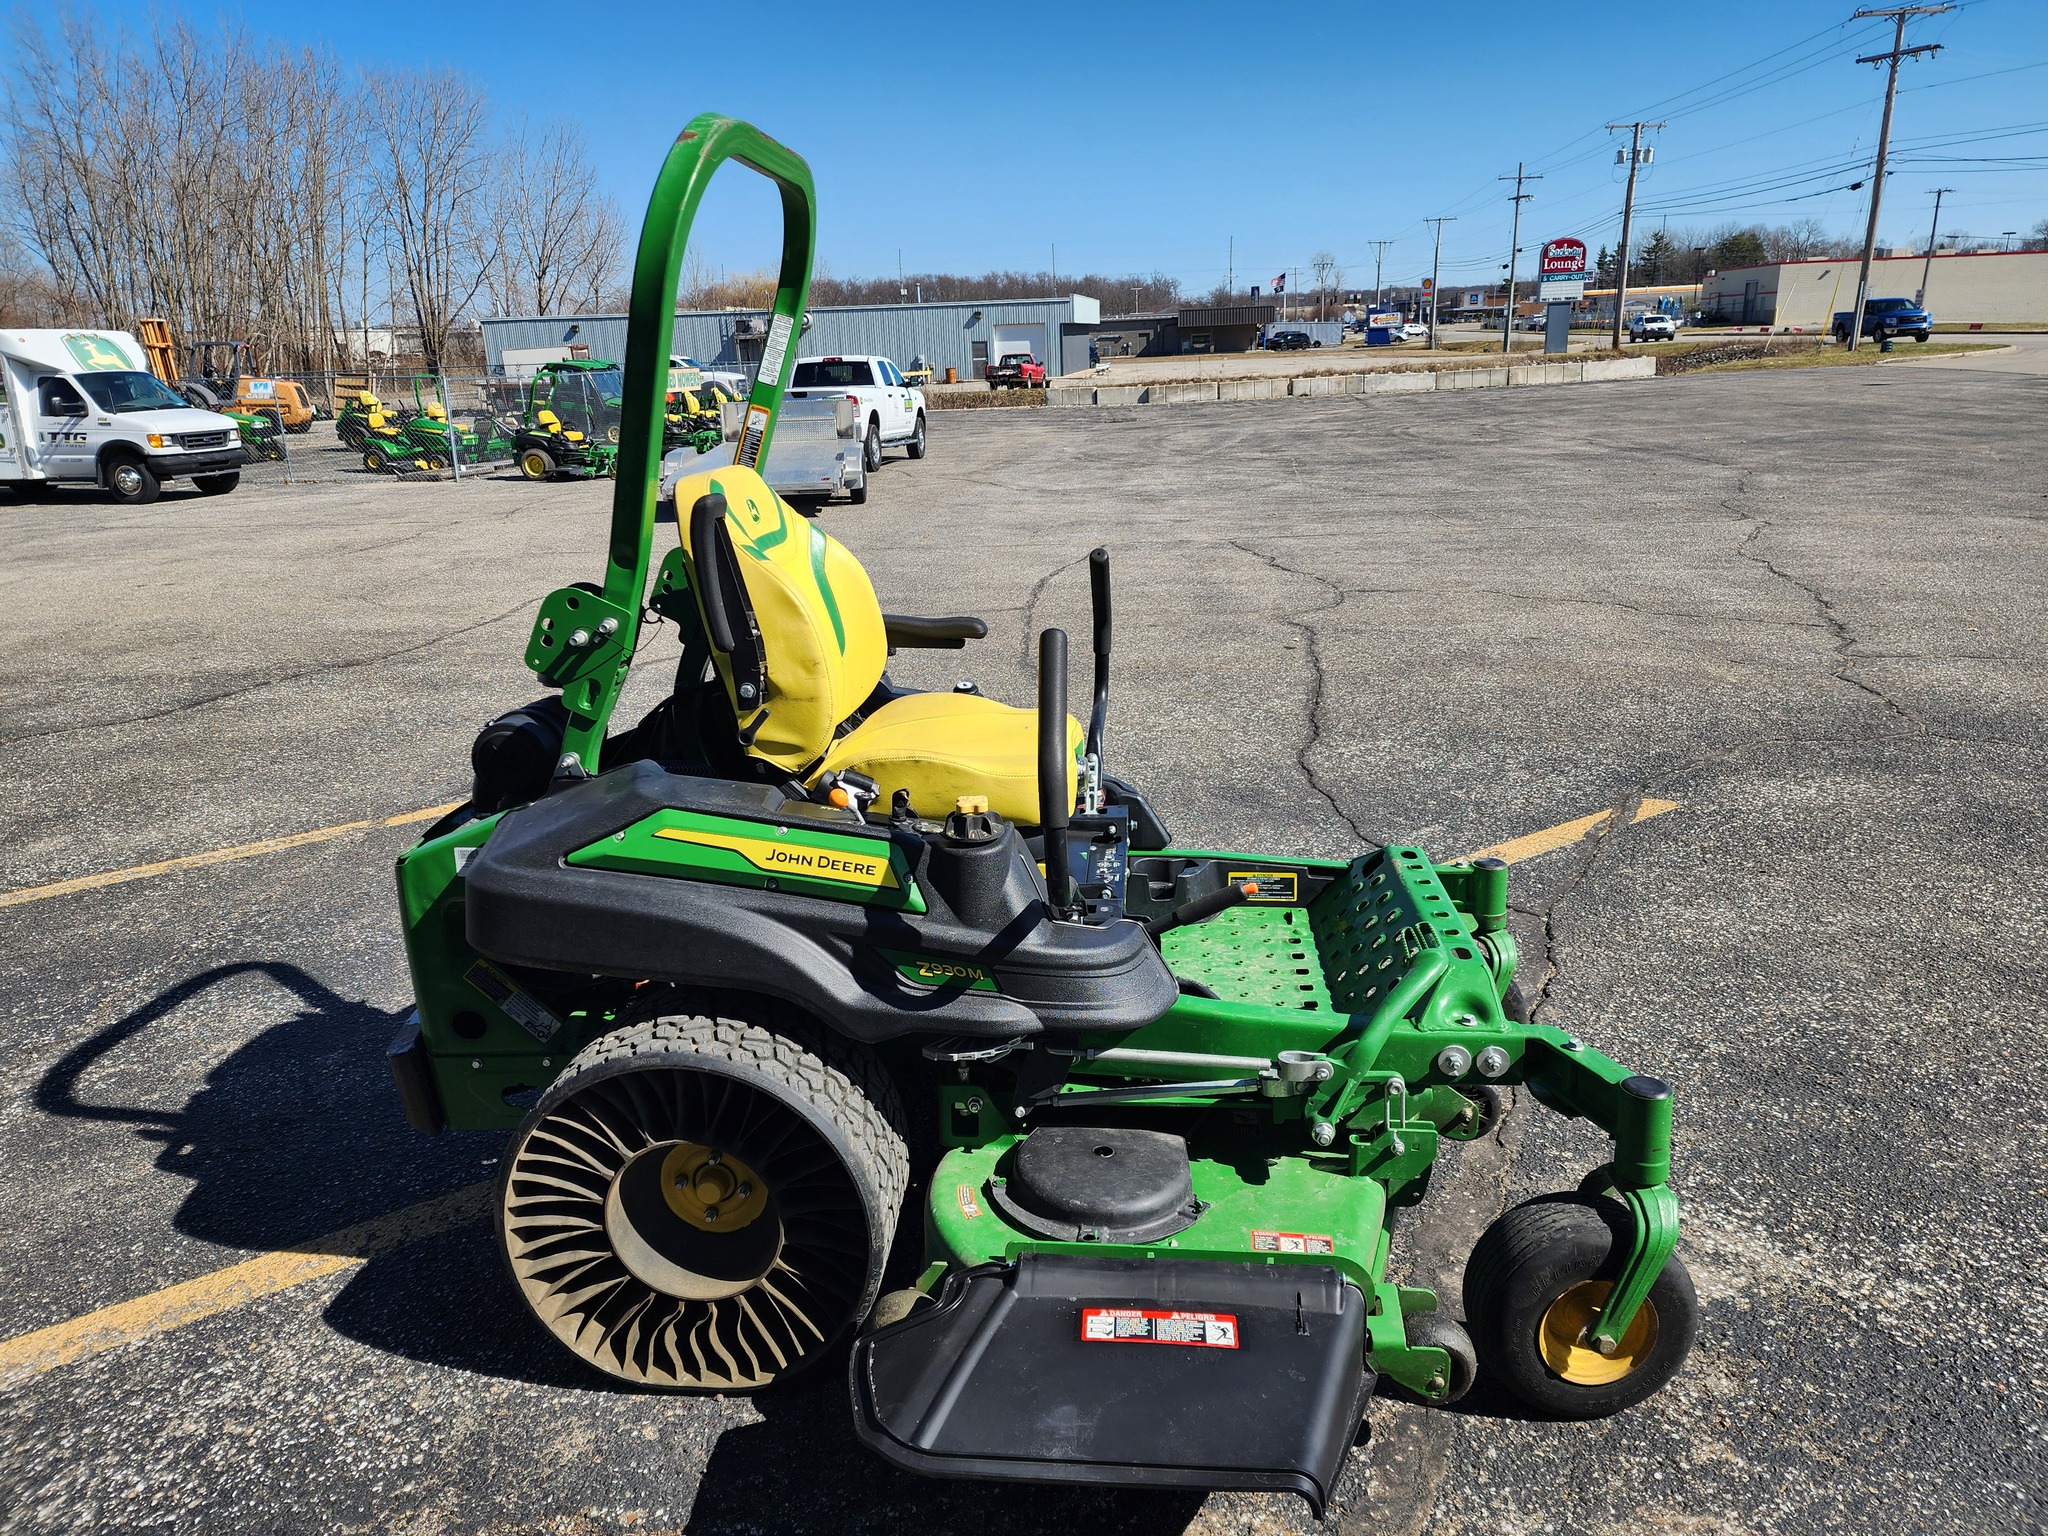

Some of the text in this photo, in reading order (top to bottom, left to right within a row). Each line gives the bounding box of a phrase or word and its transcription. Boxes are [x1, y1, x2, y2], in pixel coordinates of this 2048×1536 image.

[1543, 258, 1585, 271] Lounge
[1549, 273, 1584, 282] CARRY-OUT
[47, 432, 88, 444] TTG
[765, 848, 876, 876] JOHN DEERE
[916, 961, 984, 980] Z930M
[1530, 1254, 1602, 1298] RELIAN
[1109, 1310, 1143, 1318] DANGER
[1180, 1312, 1217, 1321] PELIGRO
[1096, 1351, 1118, 1360] DO
[1124, 1352, 1155, 1362] NOT
